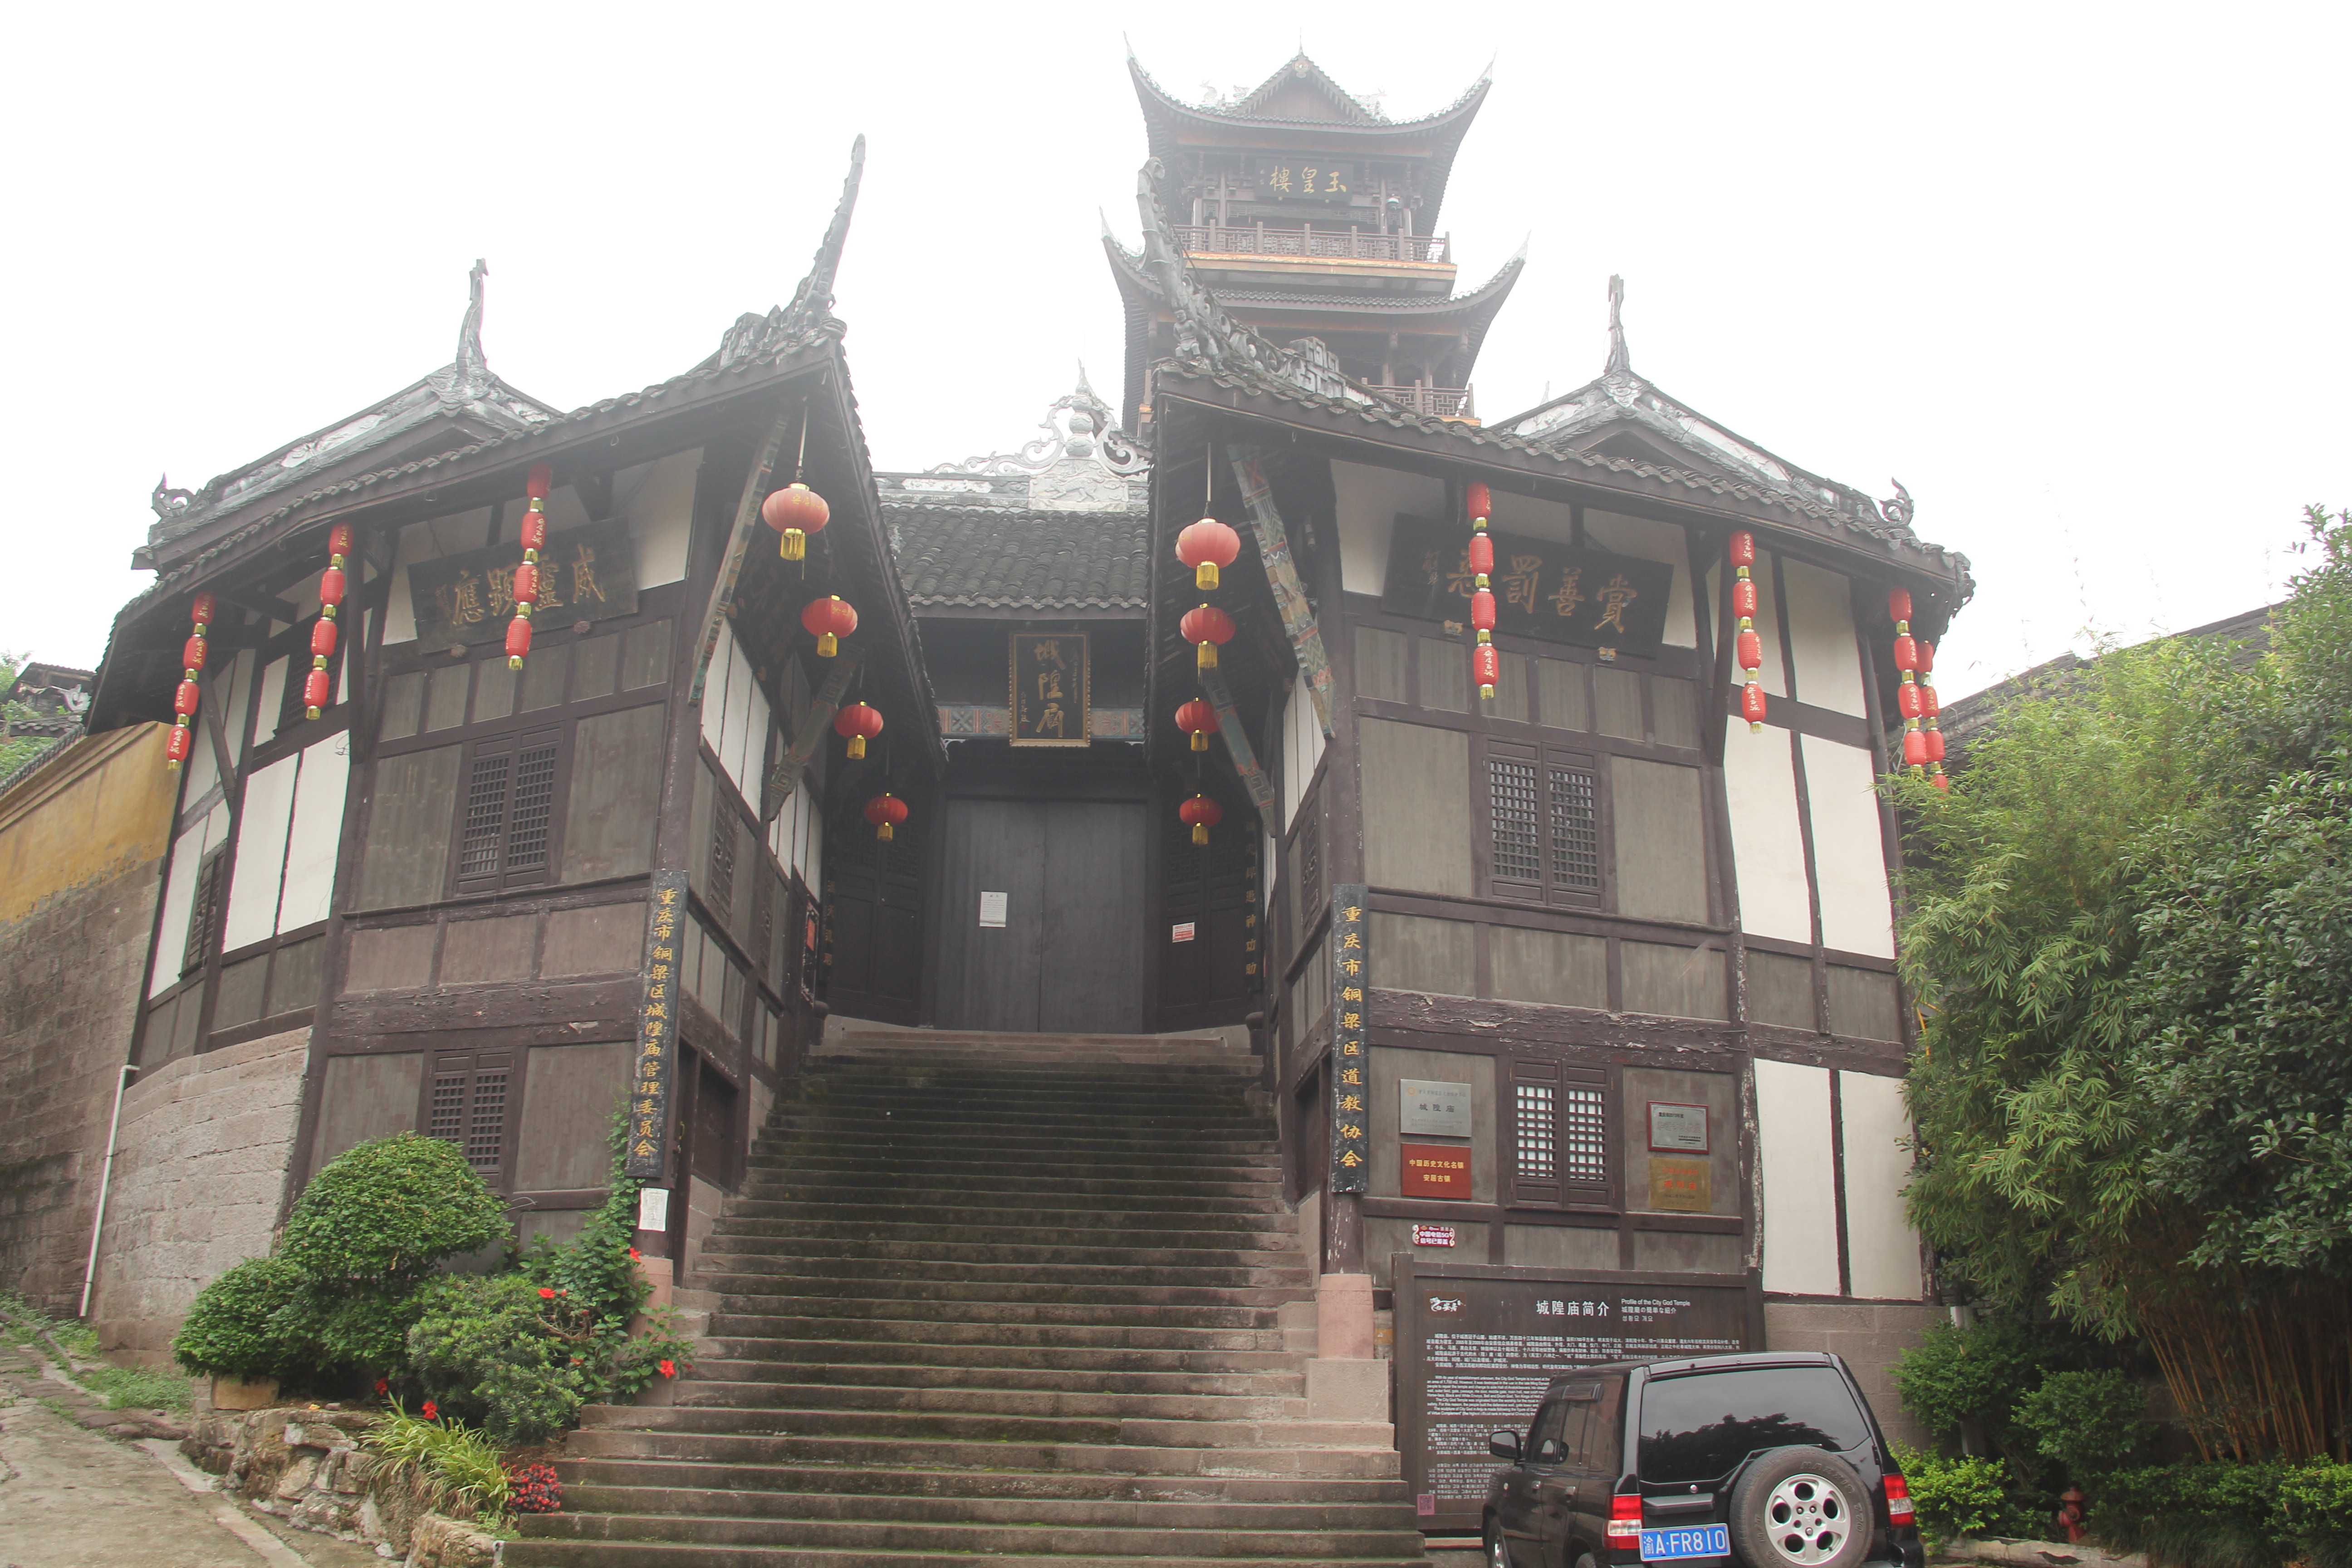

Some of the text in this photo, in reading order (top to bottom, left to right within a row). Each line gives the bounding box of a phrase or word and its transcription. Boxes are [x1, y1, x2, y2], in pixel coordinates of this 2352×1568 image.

[633, 888, 678, 1156] 重庆市铜梁区城隍庙管理委员会
[1340, 906, 1363, 1167] 重庆市铜梁区道教协会
[1419, 1103, 1455, 1112] 城隍庙
[1409, 1159, 1464, 1169] 中国历史文化名镇
[1423, 1174, 1451, 1183] 安居古镇
[1536, 1300, 1610, 1316] 城隍庙简介
